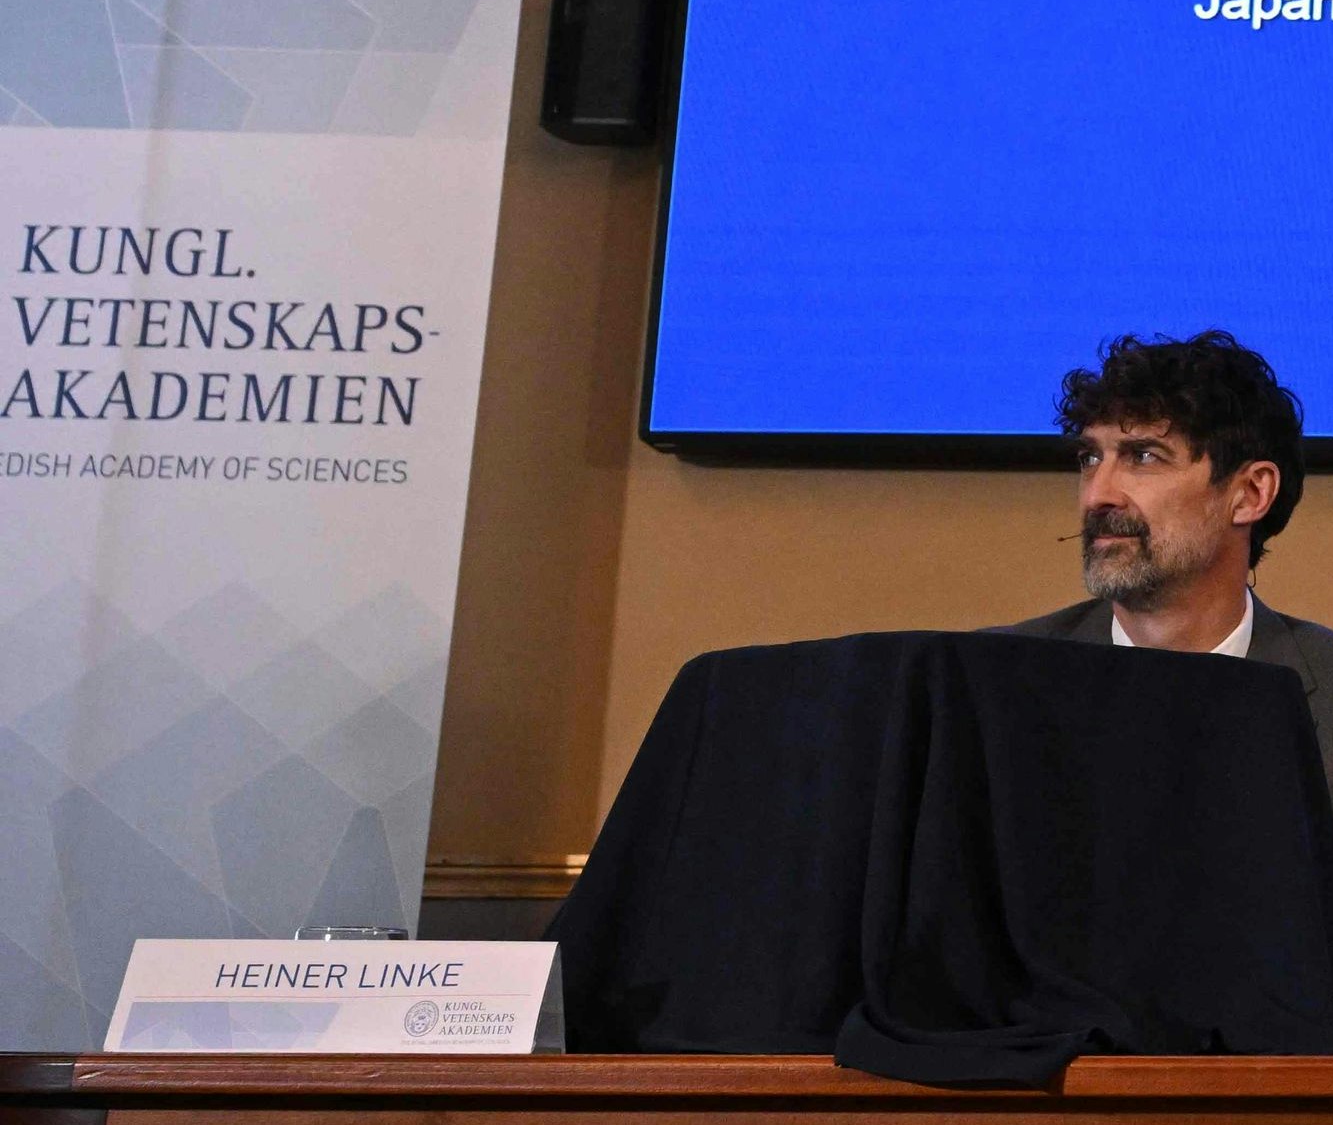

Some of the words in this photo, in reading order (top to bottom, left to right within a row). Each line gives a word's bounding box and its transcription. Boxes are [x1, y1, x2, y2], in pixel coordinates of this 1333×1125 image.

[17, 224, 257, 280] KUNGL.
[12, 296, 442, 355] VETENSKAPS-
[0, 368, 424, 426] AKADEMIEN
[0, 451, 72, 478] DISH
[79, 453, 217, 480] ACADEMY
[222, 456, 260, 481] OF
[266, 457, 409, 484] SCIENCES
[214, 962, 349, 990] HEINER
[357, 962, 465, 989] LINKE
[439, 1025, 514, 1036] AKADEMIEN
